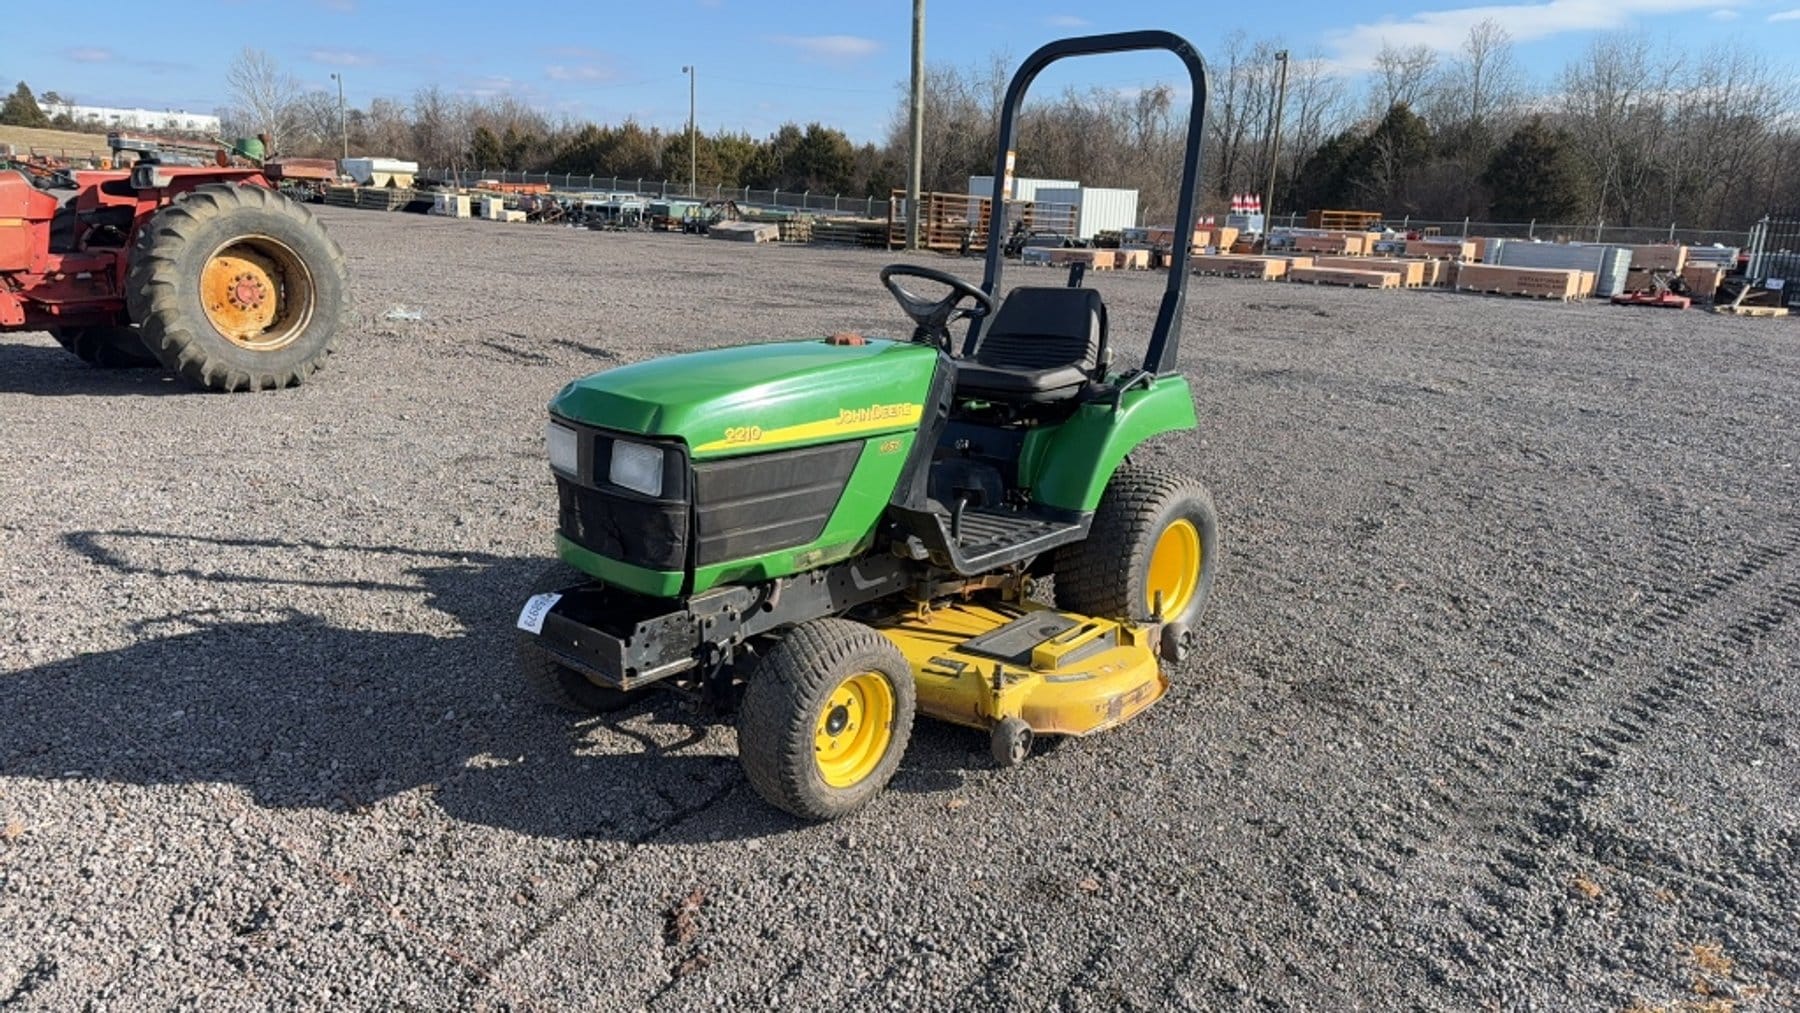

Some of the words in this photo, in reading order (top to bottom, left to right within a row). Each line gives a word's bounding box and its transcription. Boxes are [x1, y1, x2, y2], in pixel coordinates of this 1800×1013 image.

[836, 407, 872, 425] JOHN
[871, 402, 913, 420] DEERE
[724, 425, 762, 444] 2210
